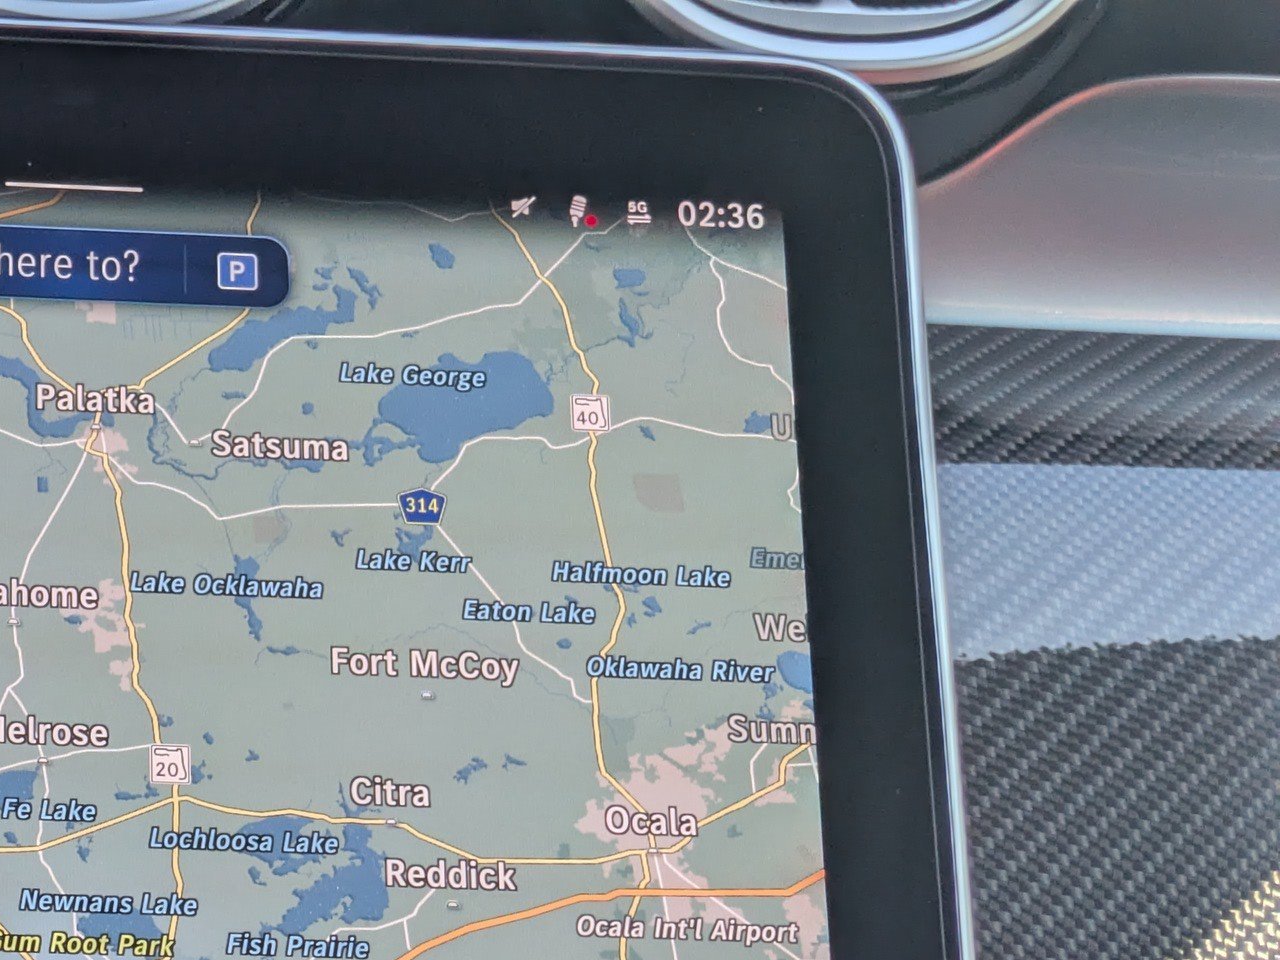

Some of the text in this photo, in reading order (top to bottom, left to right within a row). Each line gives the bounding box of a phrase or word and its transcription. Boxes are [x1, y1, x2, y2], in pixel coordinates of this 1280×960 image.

[626, 200, 648, 213] 5G
[677, 200, 765, 229] 02:36
[86, 249, 140, 282] to?
[339, 362, 487, 390] Lake George
[35, 383, 156, 414] Palatka
[576, 410, 599, 426] 40
[211, 430, 349, 462] Satsuma
[405, 498, 439, 514] 314
[356, 549, 473, 575] Lake Kerr
[552, 561, 731, 589] Halfmoon Lake
[130, 572, 324, 599] Lake Ocklawaha
[463, 600, 596, 626] Eaton Lake
[330, 647, 519, 687] Fort McCoy
[586, 656, 775, 684] Oklawaha River
[156, 762, 179, 778] 20
[350, 777, 430, 808] Citra
[2, 798, 31, 819] Fe
[40, 799, 97, 821] Lake
[604, 805, 698, 837] Ocala
[149, 827, 339, 855] Lochloosa Lake
[384, 859, 517, 892] Reddick
[19, 890, 198, 916] Newnans Lake
[576, 914, 799, 947] Ocala Int'l Airport
[49, 932, 110, 956] Root
[118, 934, 176, 959] Park
[226, 933, 370, 960] Fish Prairie
